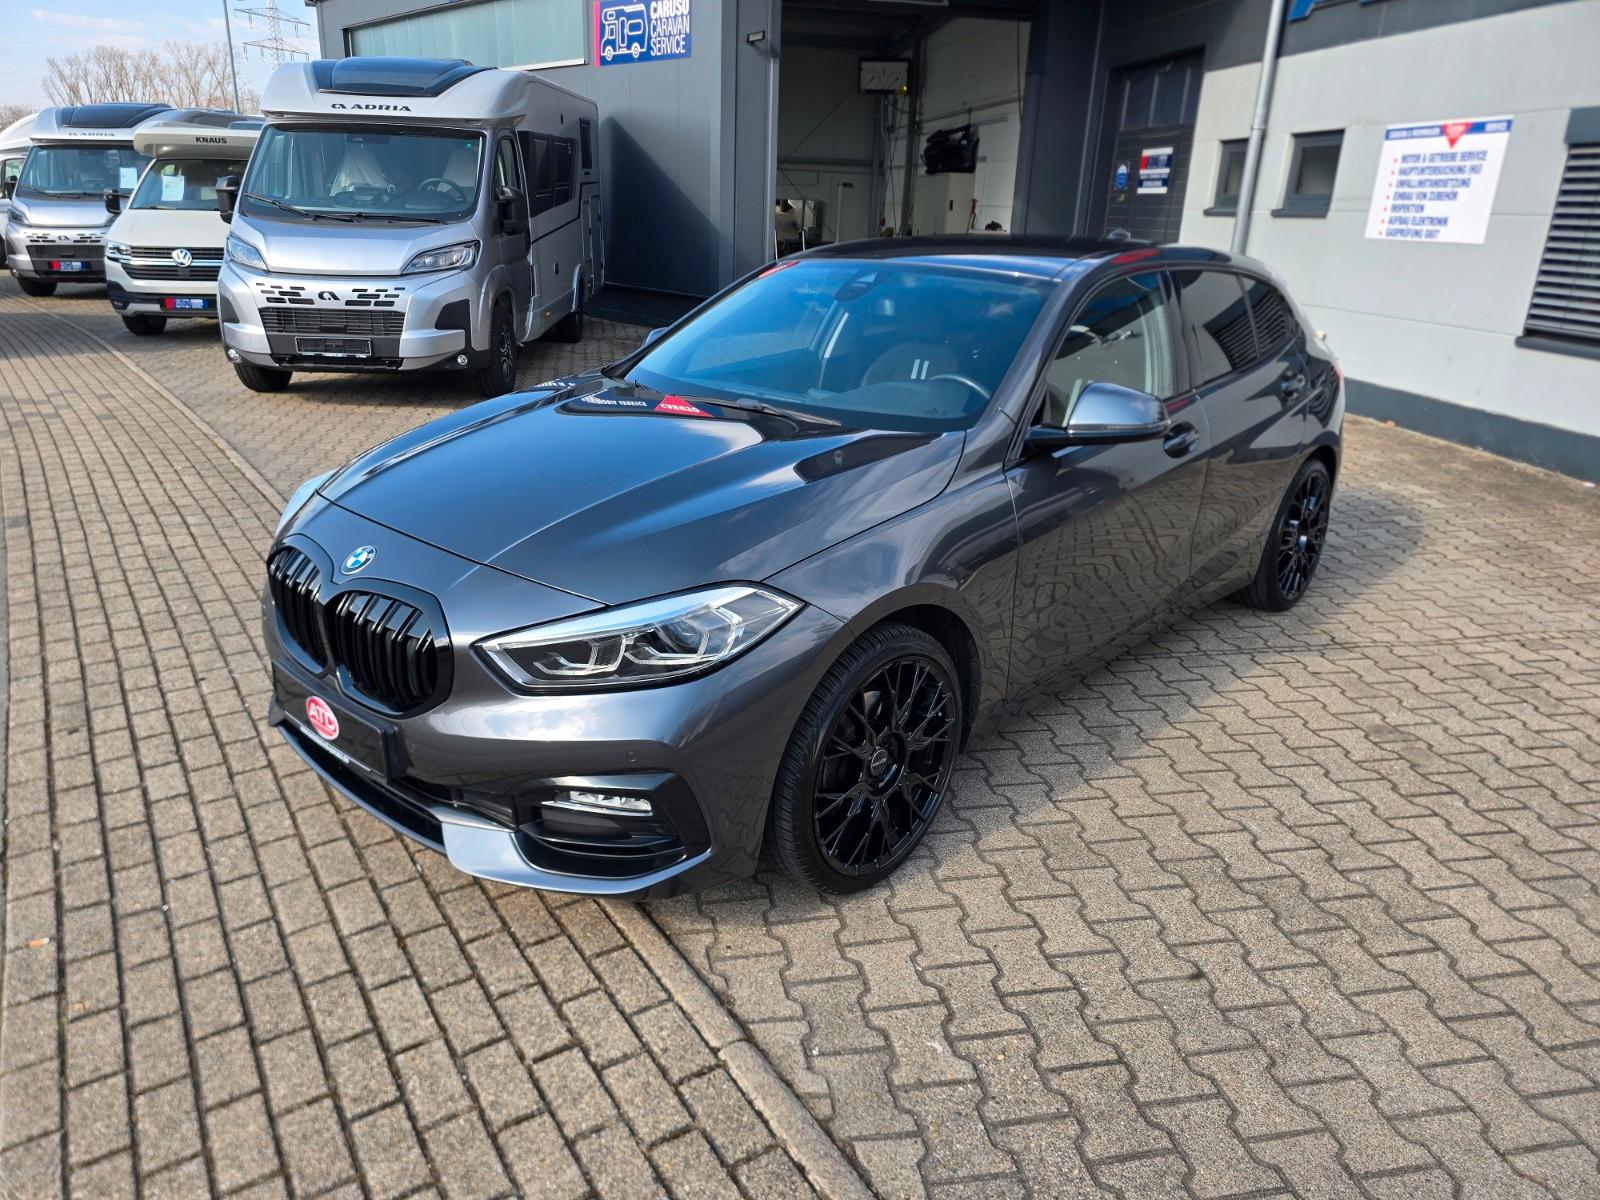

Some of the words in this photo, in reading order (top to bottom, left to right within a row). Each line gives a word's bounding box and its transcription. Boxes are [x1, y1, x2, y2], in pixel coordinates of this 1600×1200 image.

[650, 0, 690, 19] CARUSO
[650, 15, 690, 38] CARAVAN
[650, 34, 686, 56] SERVICE
[350, 103, 411, 112] ADRIA
[195, 136, 227, 144] KNAUS
[1460, 151, 1487, 161] SERVICE
